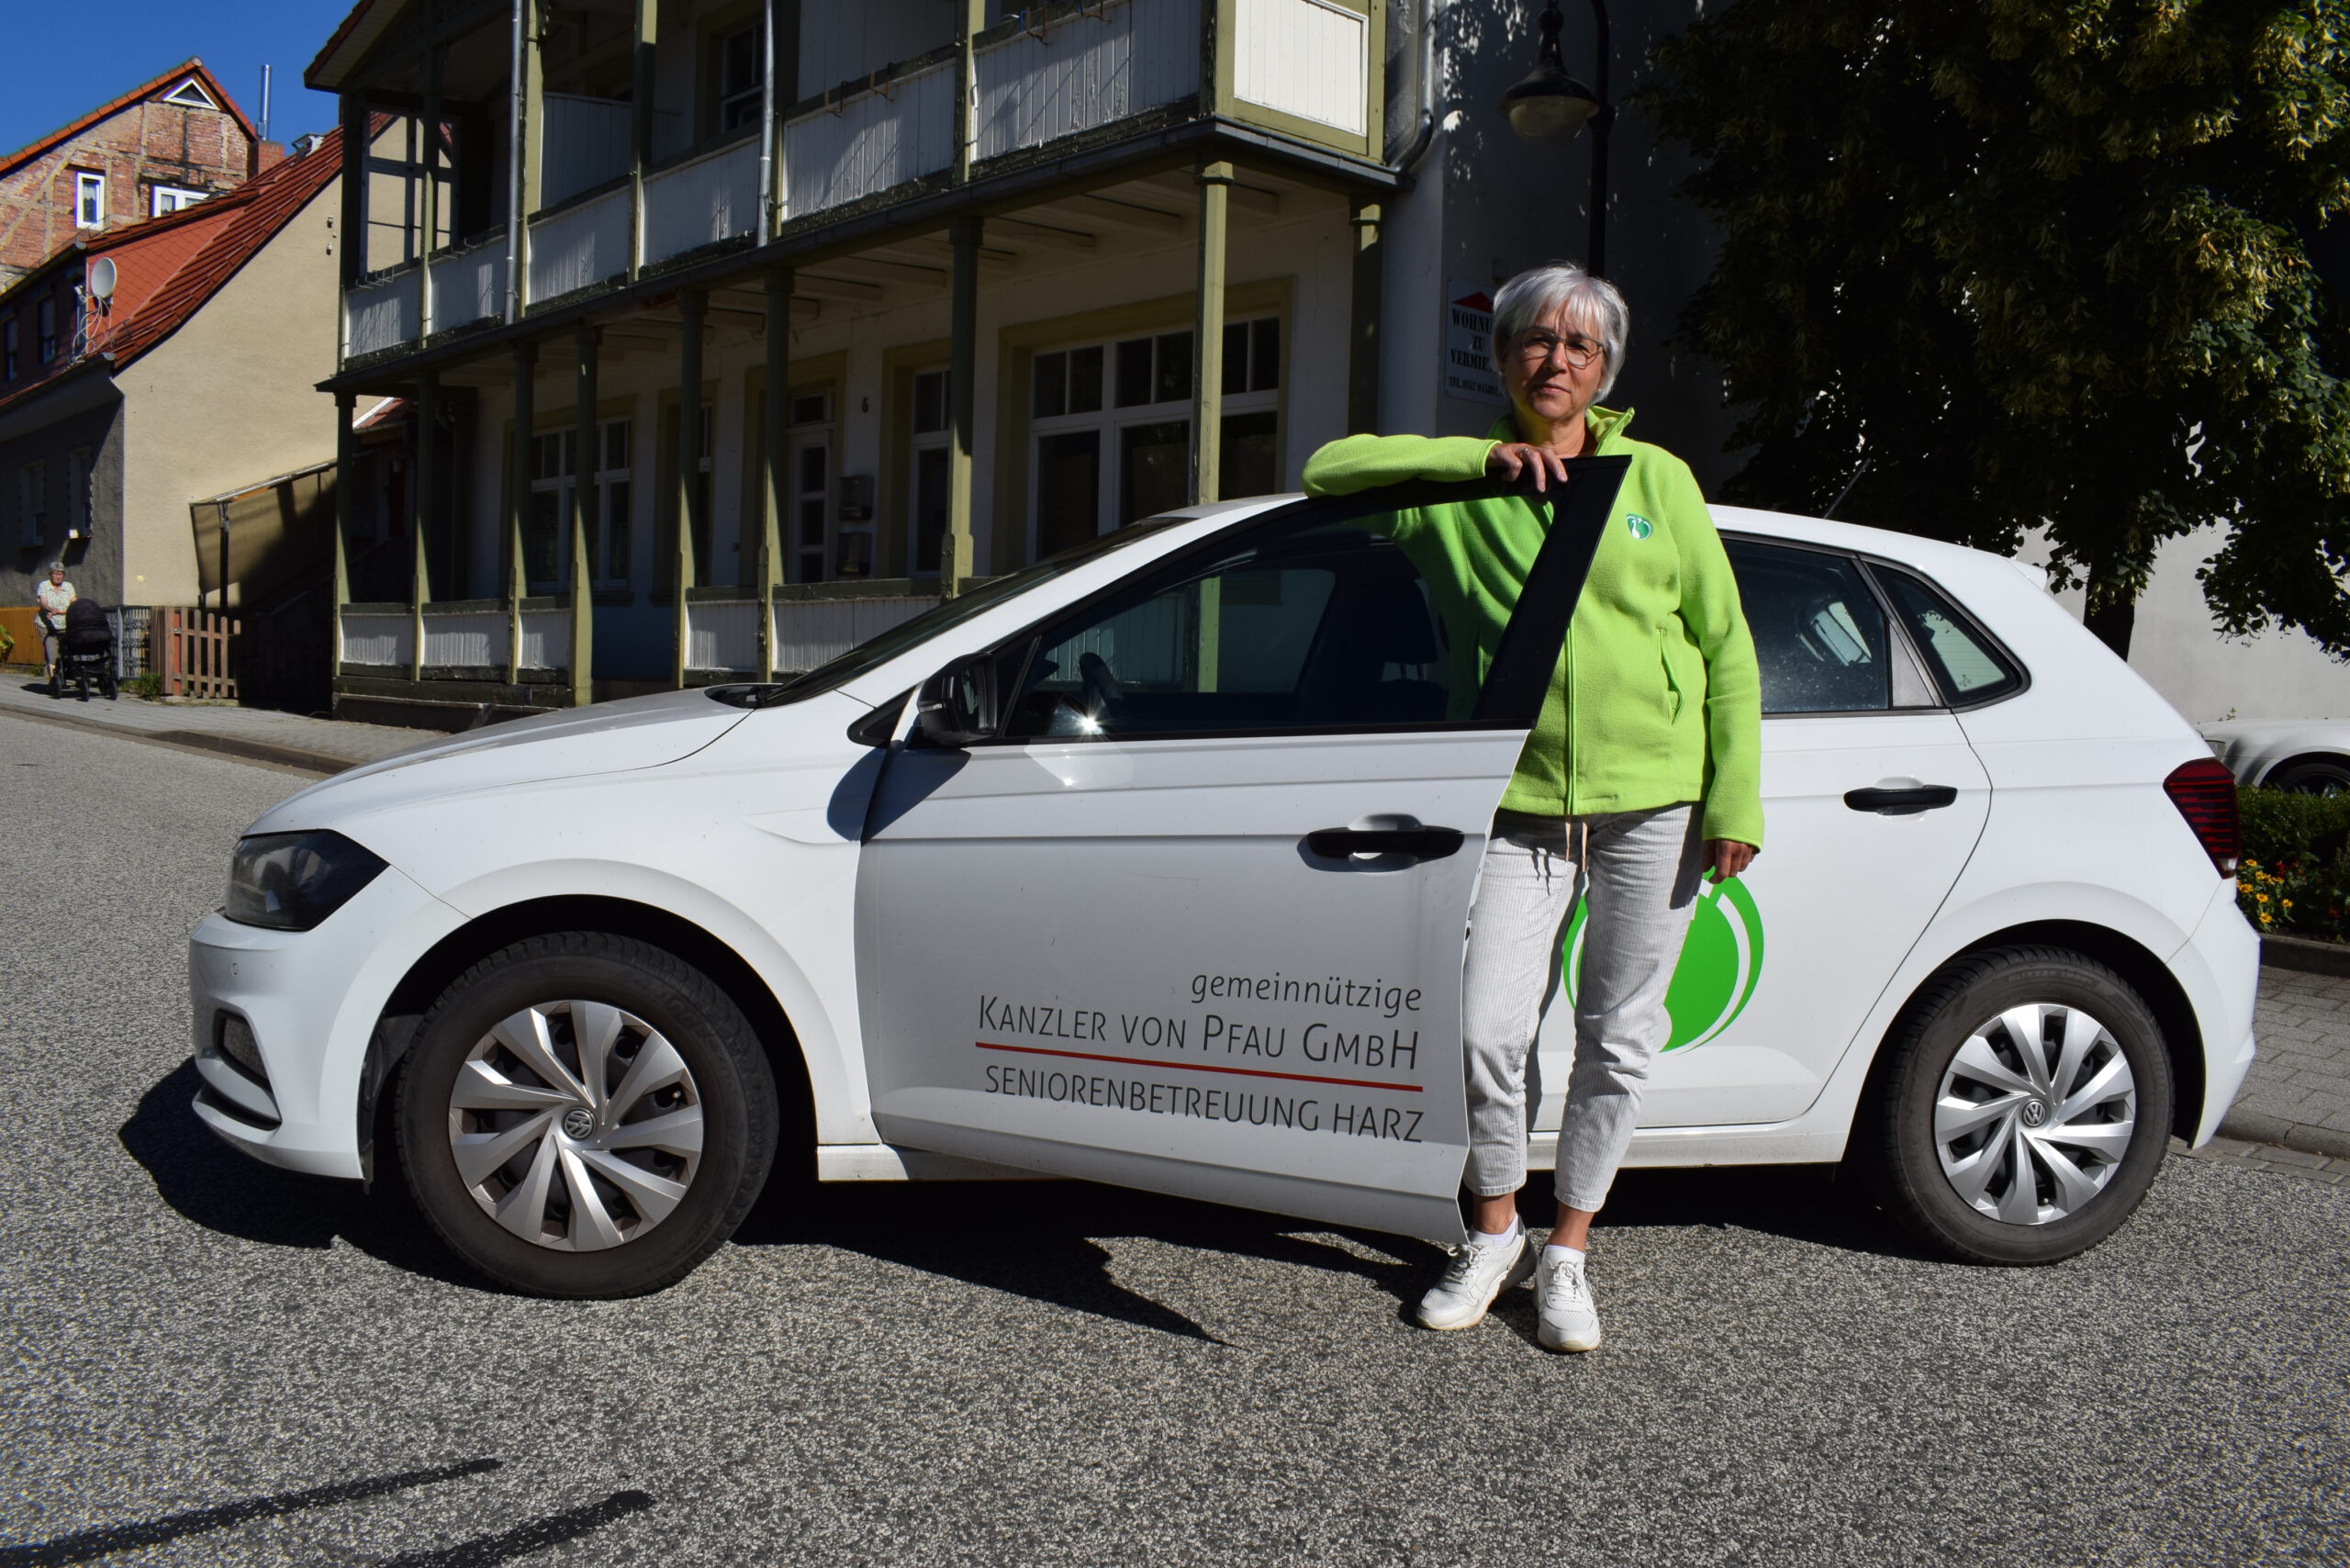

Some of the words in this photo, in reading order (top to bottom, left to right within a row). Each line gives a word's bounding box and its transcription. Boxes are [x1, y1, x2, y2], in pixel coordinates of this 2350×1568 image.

[1451, 308, 1494, 334] WOHNU
[1472, 335, 1485, 352] ZU
[1450, 349, 1492, 372] VERMIE
[1191, 971, 1422, 1019] gemeinnützige
[984, 1065, 1320, 1132] SENIORENBETREUUNG
[1333, 1103, 1425, 1144] HARZ
